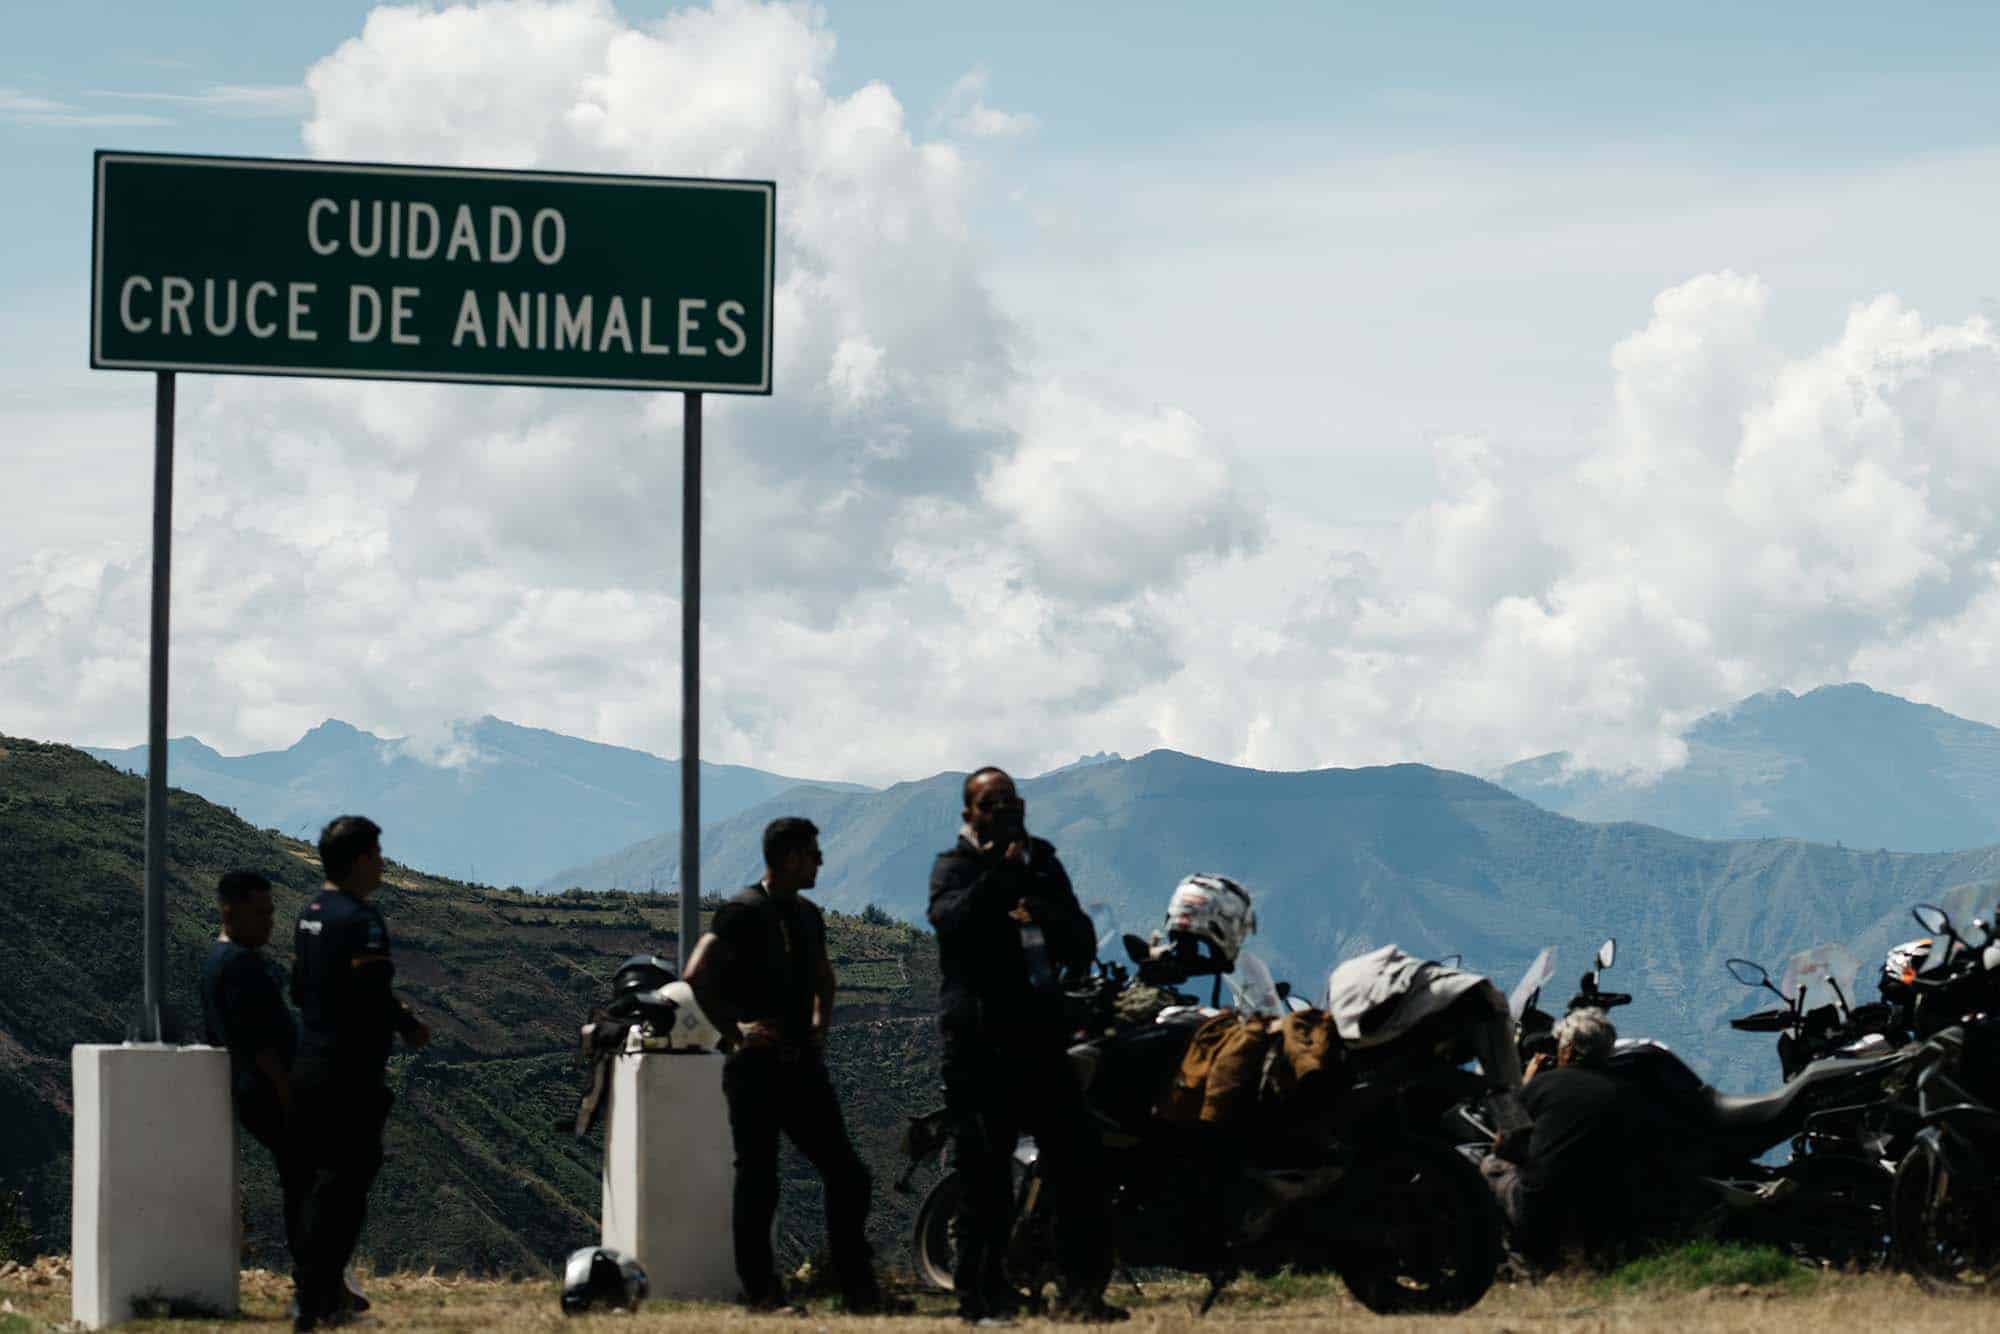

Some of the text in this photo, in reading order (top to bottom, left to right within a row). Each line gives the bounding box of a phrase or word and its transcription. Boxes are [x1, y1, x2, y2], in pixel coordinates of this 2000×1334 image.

[308, 198, 566, 265] CUIDADO
[120, 276, 747, 357] CRUCE DE ANIMALES
